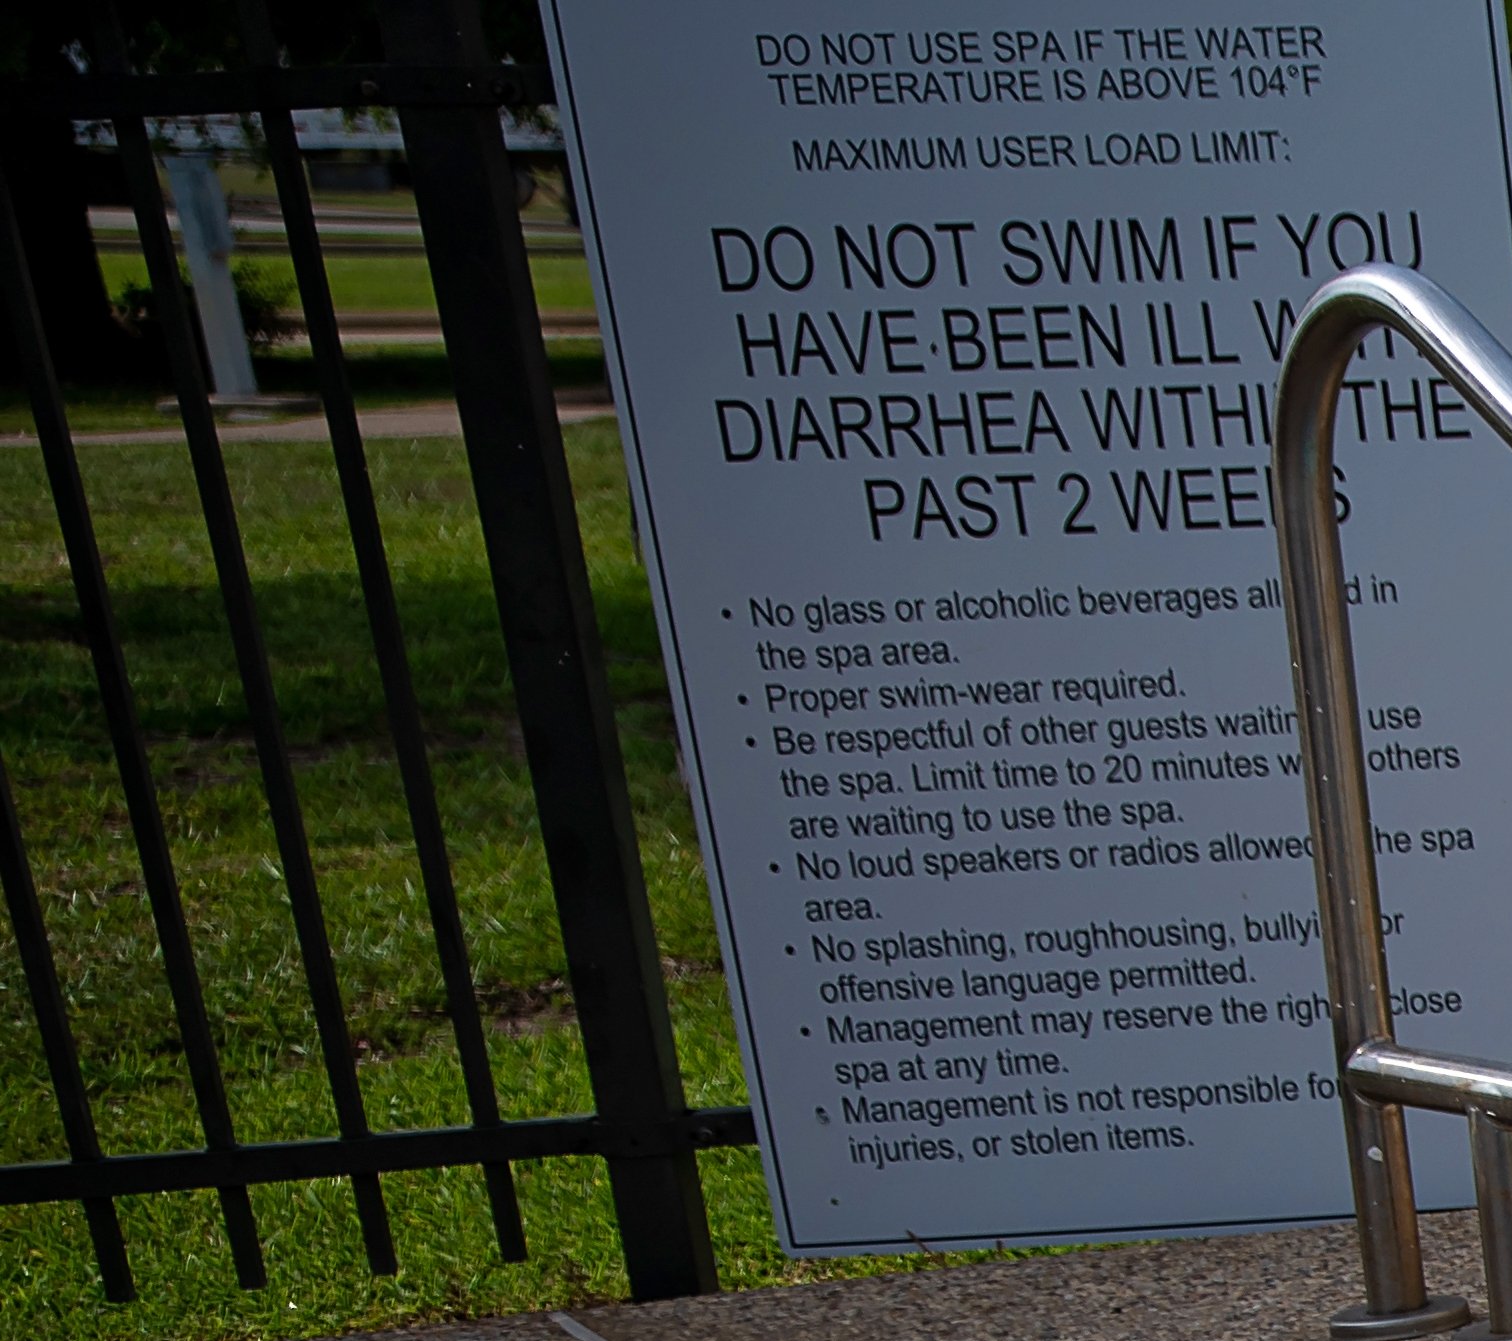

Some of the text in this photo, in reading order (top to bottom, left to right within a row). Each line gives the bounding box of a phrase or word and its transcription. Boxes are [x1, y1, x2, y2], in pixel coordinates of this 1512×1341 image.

[755, 25, 1326, 66] DO NOT USE SPA IF THE WATER
[766, 63, 1321, 106] TEMPERATURE IS ABOVE 104°F
[791, 129, 1291, 172] MAXIMUM USER LOAD LIMIT:
[710, 209, 1424, 293] DO NOT SWIM IF YOU
[735, 308, 926, 378] HAVE
[940, 303, 1126, 372] BEEN
[1144, 300, 1241, 366] ILL
[714, 375, 1473, 463] DIARRHEA WITHI THE
[862, 464, 1352, 542] PAST 2 WEES
[748, 573, 1398, 630] No glass or alcoholic beverages alld in
[755, 639, 959, 675] the spa area.
[764, 666, 1186, 717] Proper swim-wear required.
[819, 954, 1256, 1004] offensive language permitted.
[847, 1122, 1194, 1170] injuries, or stolen items.
